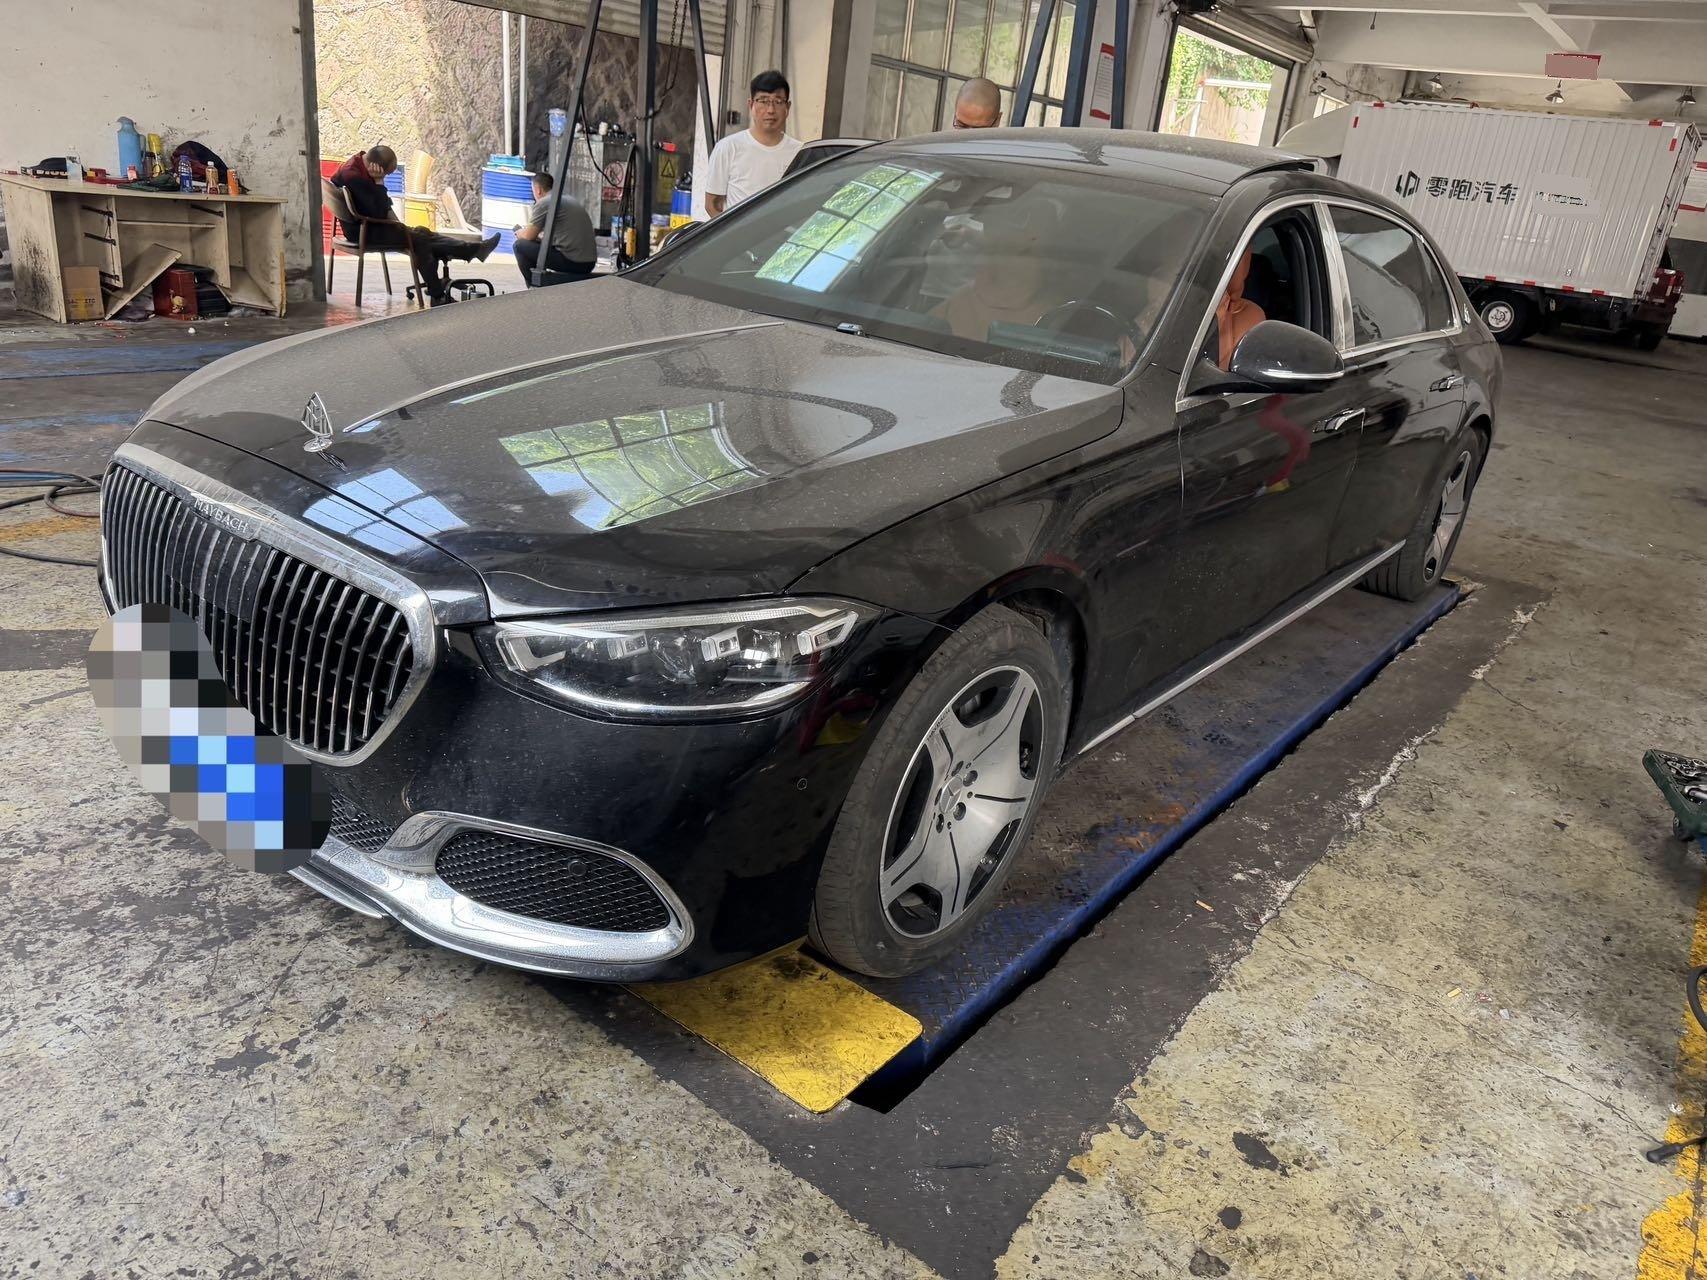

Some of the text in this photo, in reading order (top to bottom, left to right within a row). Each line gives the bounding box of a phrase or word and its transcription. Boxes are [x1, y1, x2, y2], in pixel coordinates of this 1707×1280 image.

[1425, 176, 1518, 205] 零跑汽车
[194, 498, 249, 534] MAYBACH
